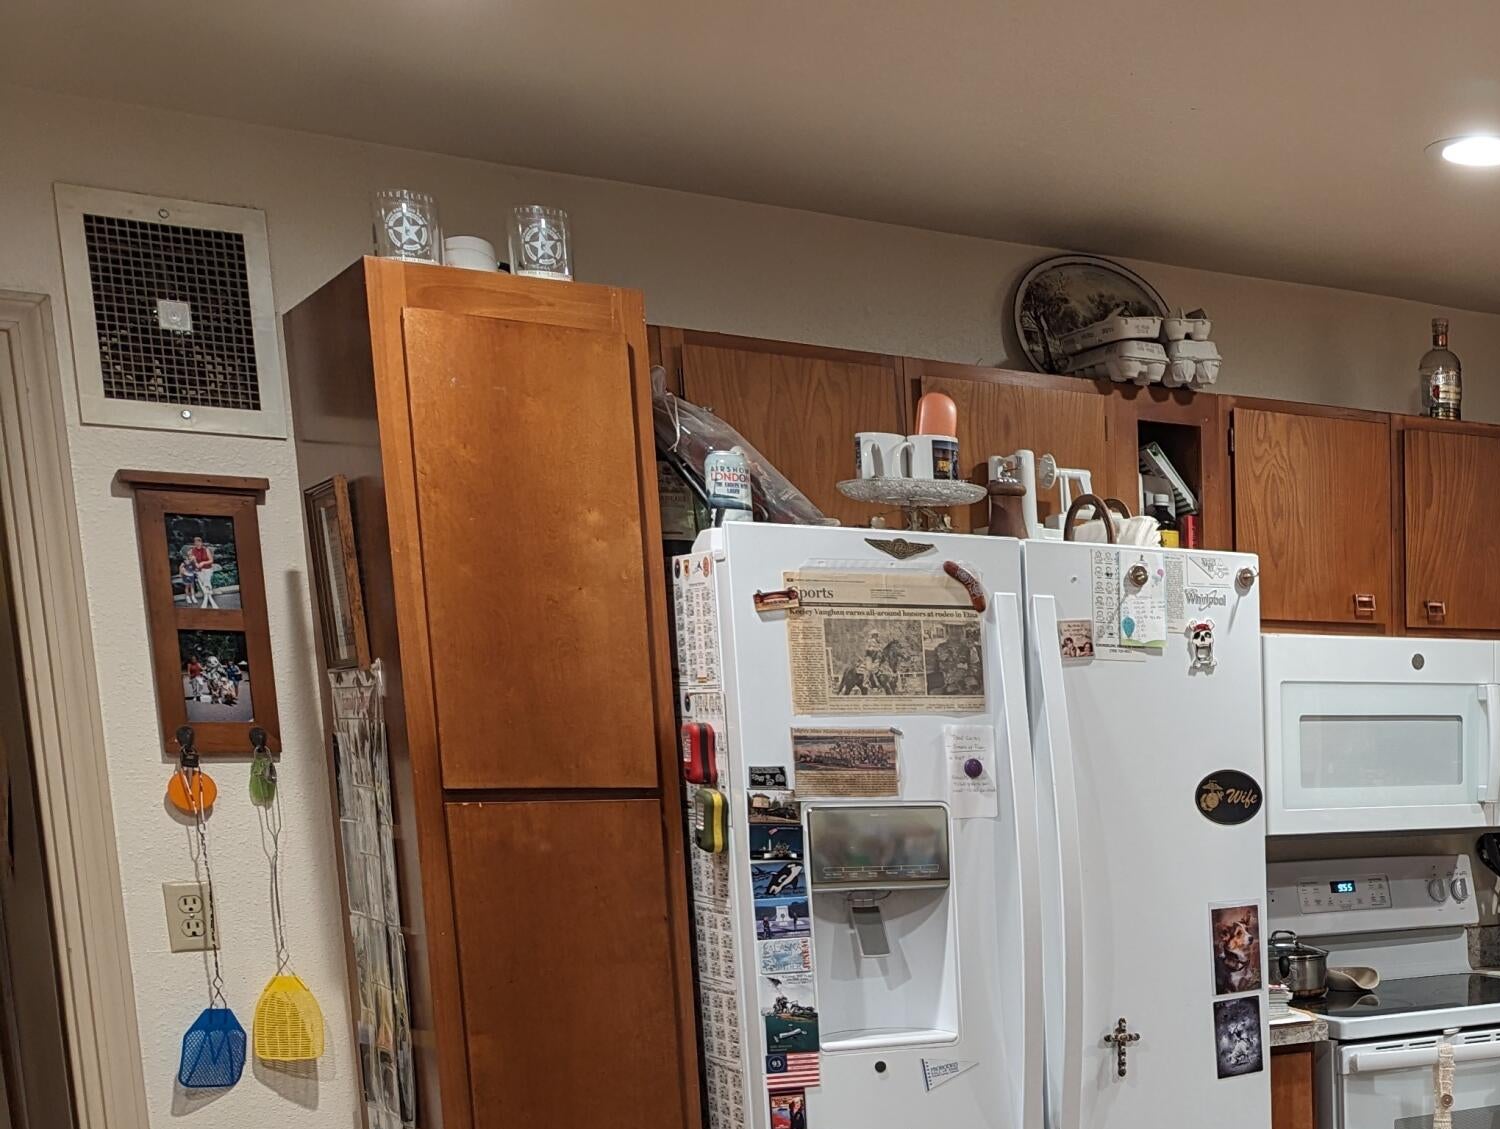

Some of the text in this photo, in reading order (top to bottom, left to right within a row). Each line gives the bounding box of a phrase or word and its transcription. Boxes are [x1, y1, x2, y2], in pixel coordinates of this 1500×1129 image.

[1184, 588, 1227, 611] Whirlpool
[1226, 788, 1258, 809] Wife
[771, 1060, 782, 1069] 93
